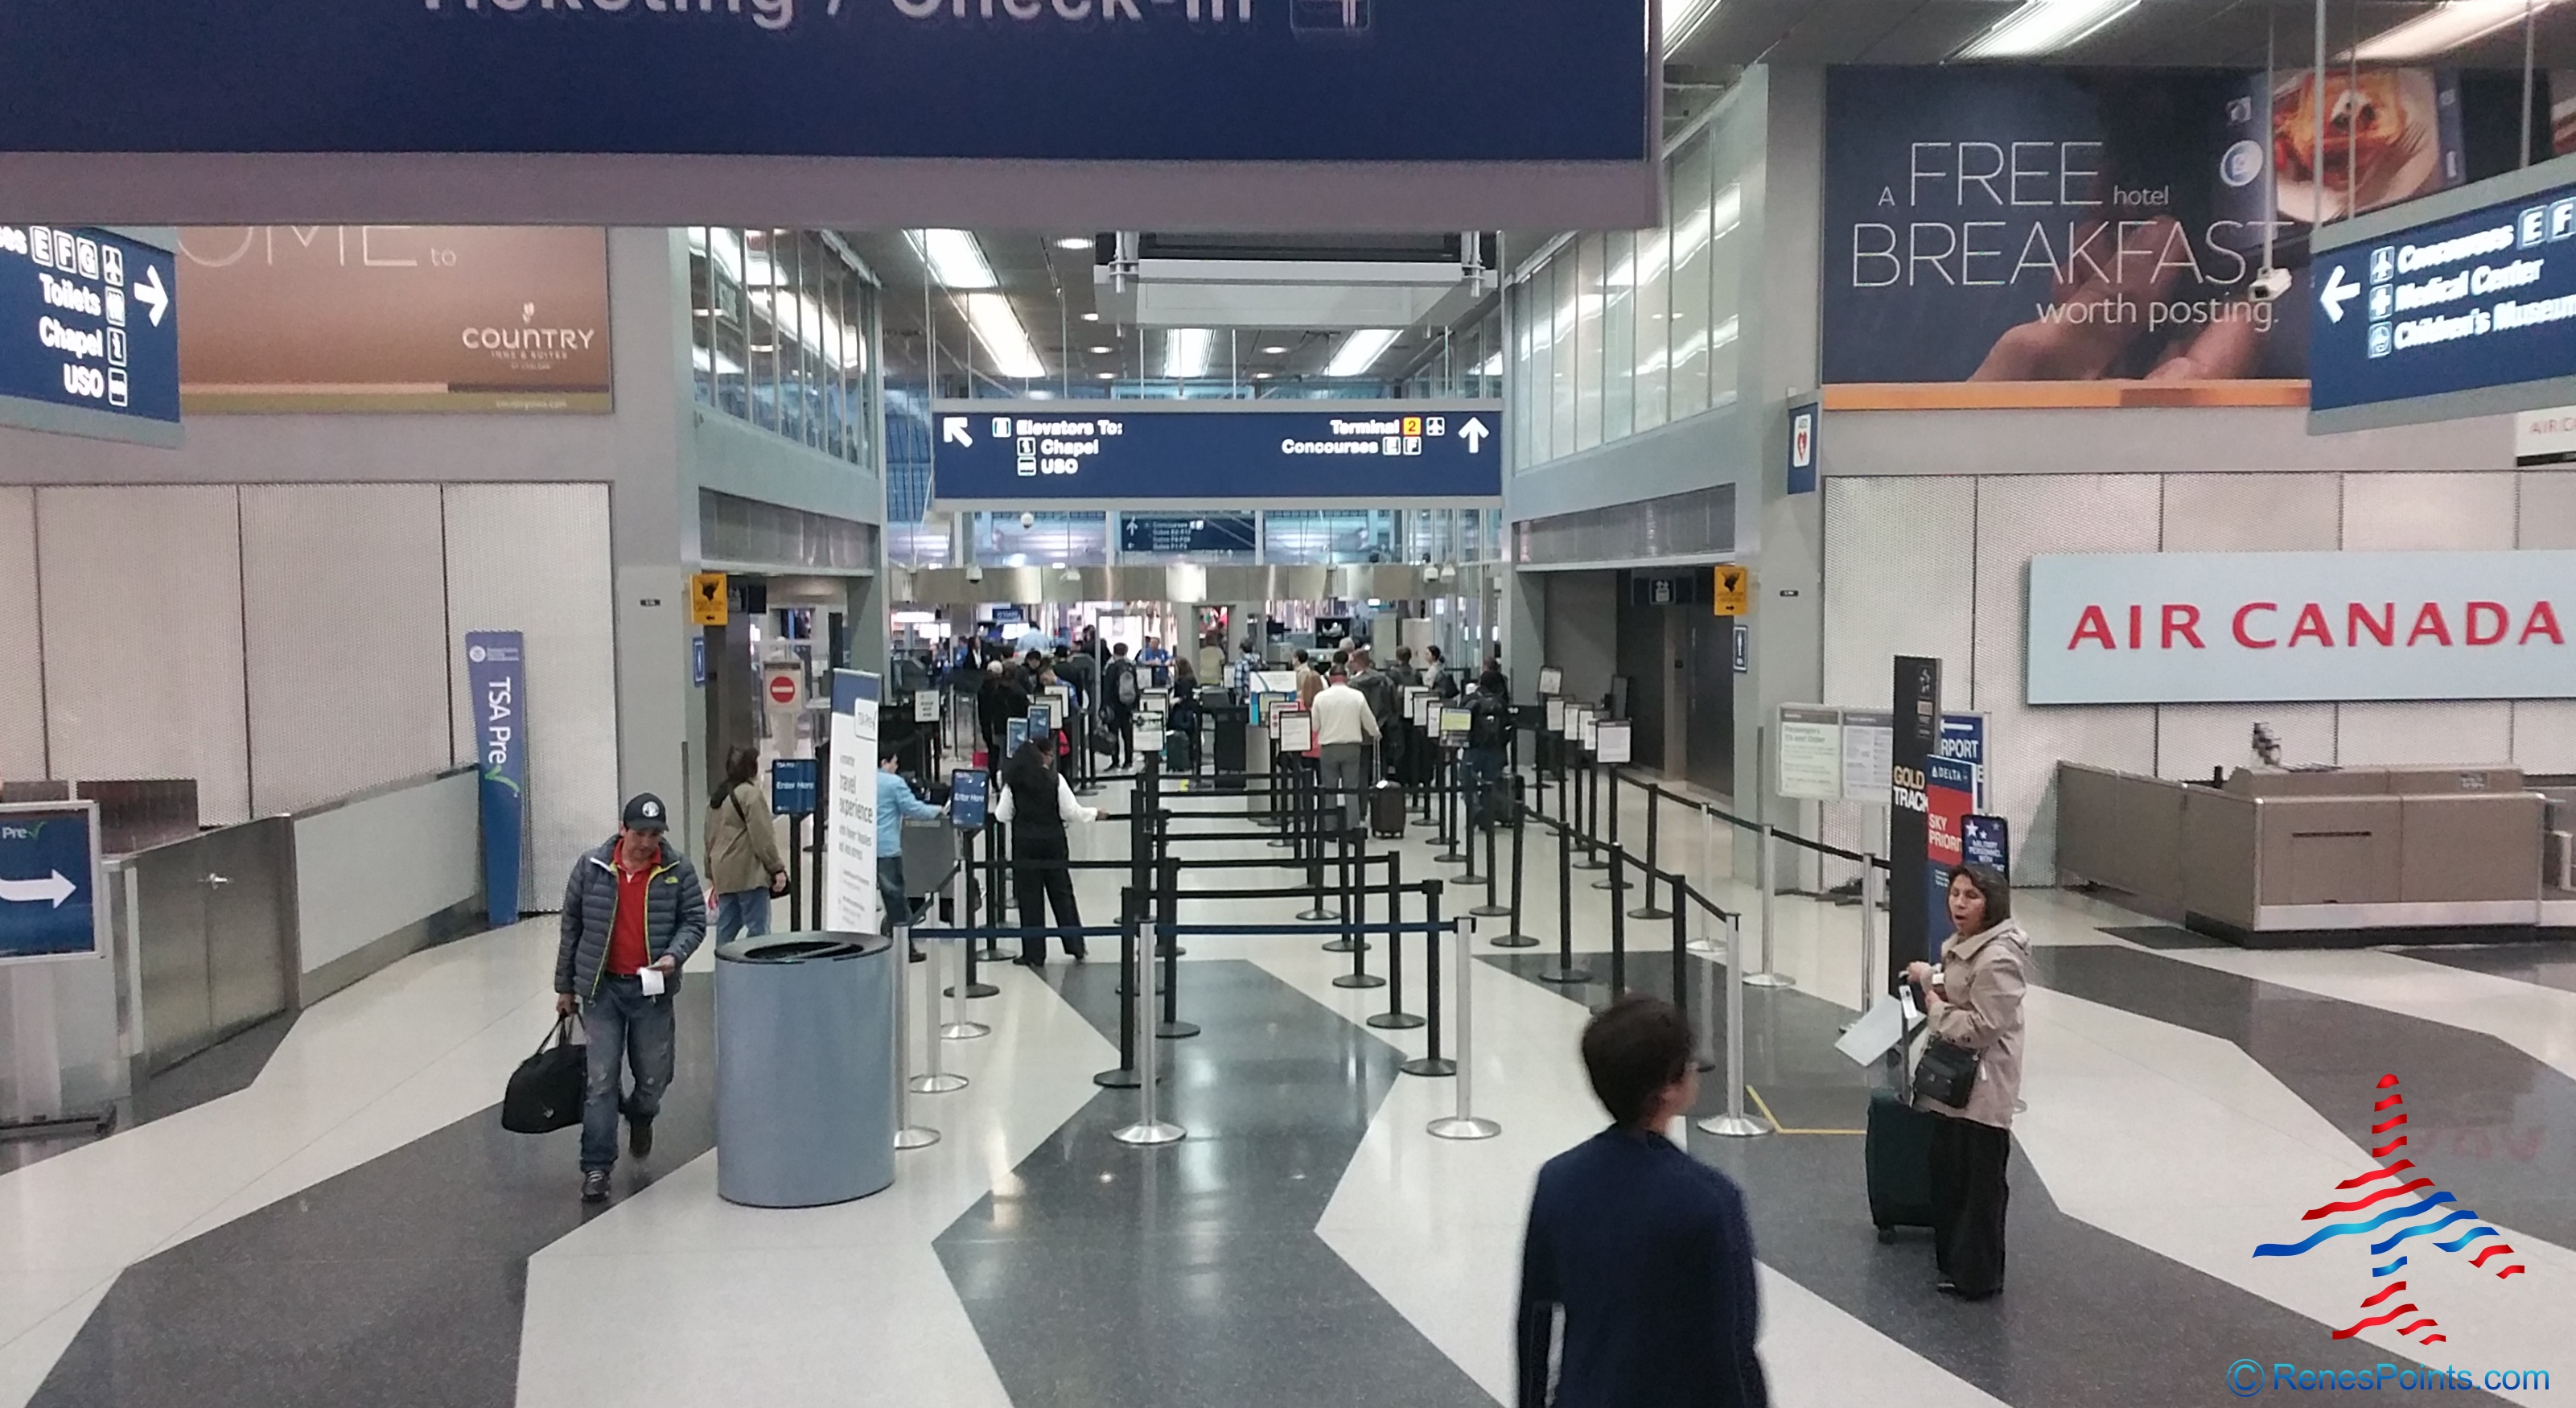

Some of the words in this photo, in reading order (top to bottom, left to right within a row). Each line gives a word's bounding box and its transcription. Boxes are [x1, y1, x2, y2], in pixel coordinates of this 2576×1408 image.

[1878, 187, 1895, 205] A
[1908, 142, 2102, 206] FREE
[2113, 185, 2170, 206] hotel
[2397, 224, 2515, 274] Concourses
[2523, 211, 2544, 244] E
[431, 247, 456, 267] to
[39, 273, 101, 316] Toilets
[2395, 270, 2470, 313] Medical
[2471, 258, 2545, 296] Center
[2037, 293, 2136, 323] worth
[2148, 291, 2279, 332] posting.
[39, 315, 103, 359] Chapel
[2393, 307, 2492, 351] Children's
[64, 363, 105, 398] USO
[1016, 419, 1094, 435] Elevators
[1097, 419, 1123, 435] To:
[1330, 418, 1400, 434] Terminal
[1040, 438, 1099, 457] Chapel
[1281, 438, 1379, 454] Concourses
[1040, 458, 1078, 474] USO
[2067, 603, 2206, 650] AIR
[2232, 600, 2566, 648] CANADA
[488, 676, 511, 721] TSA
[488, 726, 511, 764] Pre
[776, 780, 796, 789] Enter
[1894, 765, 1926, 791] GOLD
[1937, 767, 1963, 783] DELTA
[2, 826, 27, 839] Pre
[1929, 813, 1948, 831] SKY
[1928, 830, 1962, 852] PRIORIT
